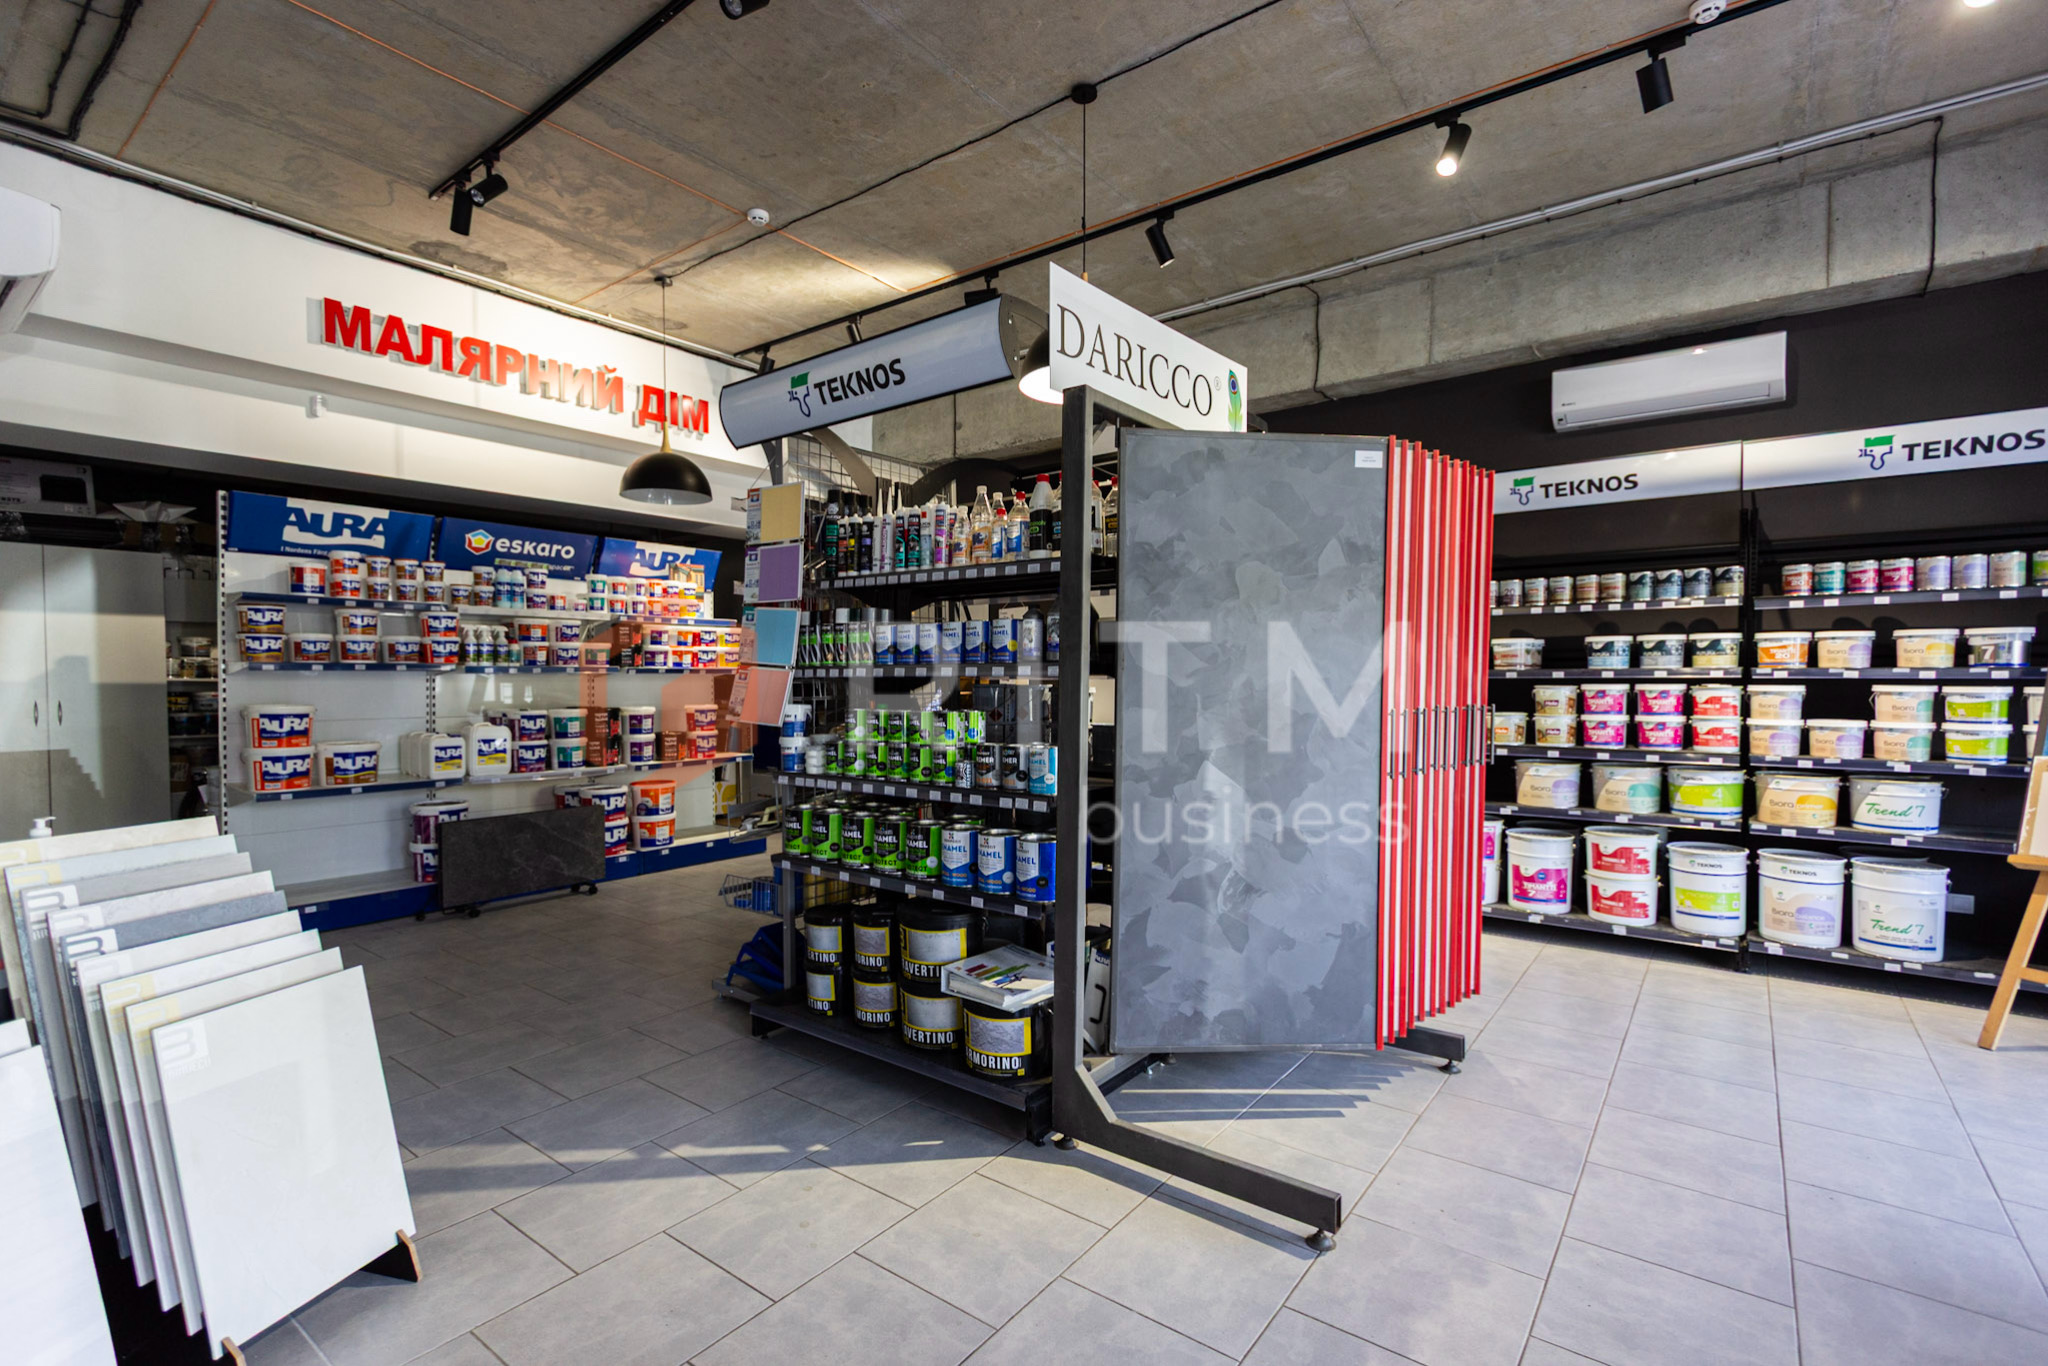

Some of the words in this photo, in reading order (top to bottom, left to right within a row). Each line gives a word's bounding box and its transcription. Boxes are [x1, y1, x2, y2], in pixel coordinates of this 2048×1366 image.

[322, 297, 624, 414] МАЛЯРНИЙ
[637, 383, 709, 435] ДІМ
[1056, 303, 1213, 416] DARICCO
[813, 357, 906, 406] TEKNOS
[1901, 428, 2046, 463] TEKNOS
[1539, 472, 1639, 500] TEKNOS
[285, 506, 390, 540] AURA
[495, 538, 576, 560] eskaro
[1981, 645, 1995, 660] 7
[259, 717, 310, 733] AURA
[1865, 802, 1913, 818] Trend
[1870, 918, 1912, 934] Trend
